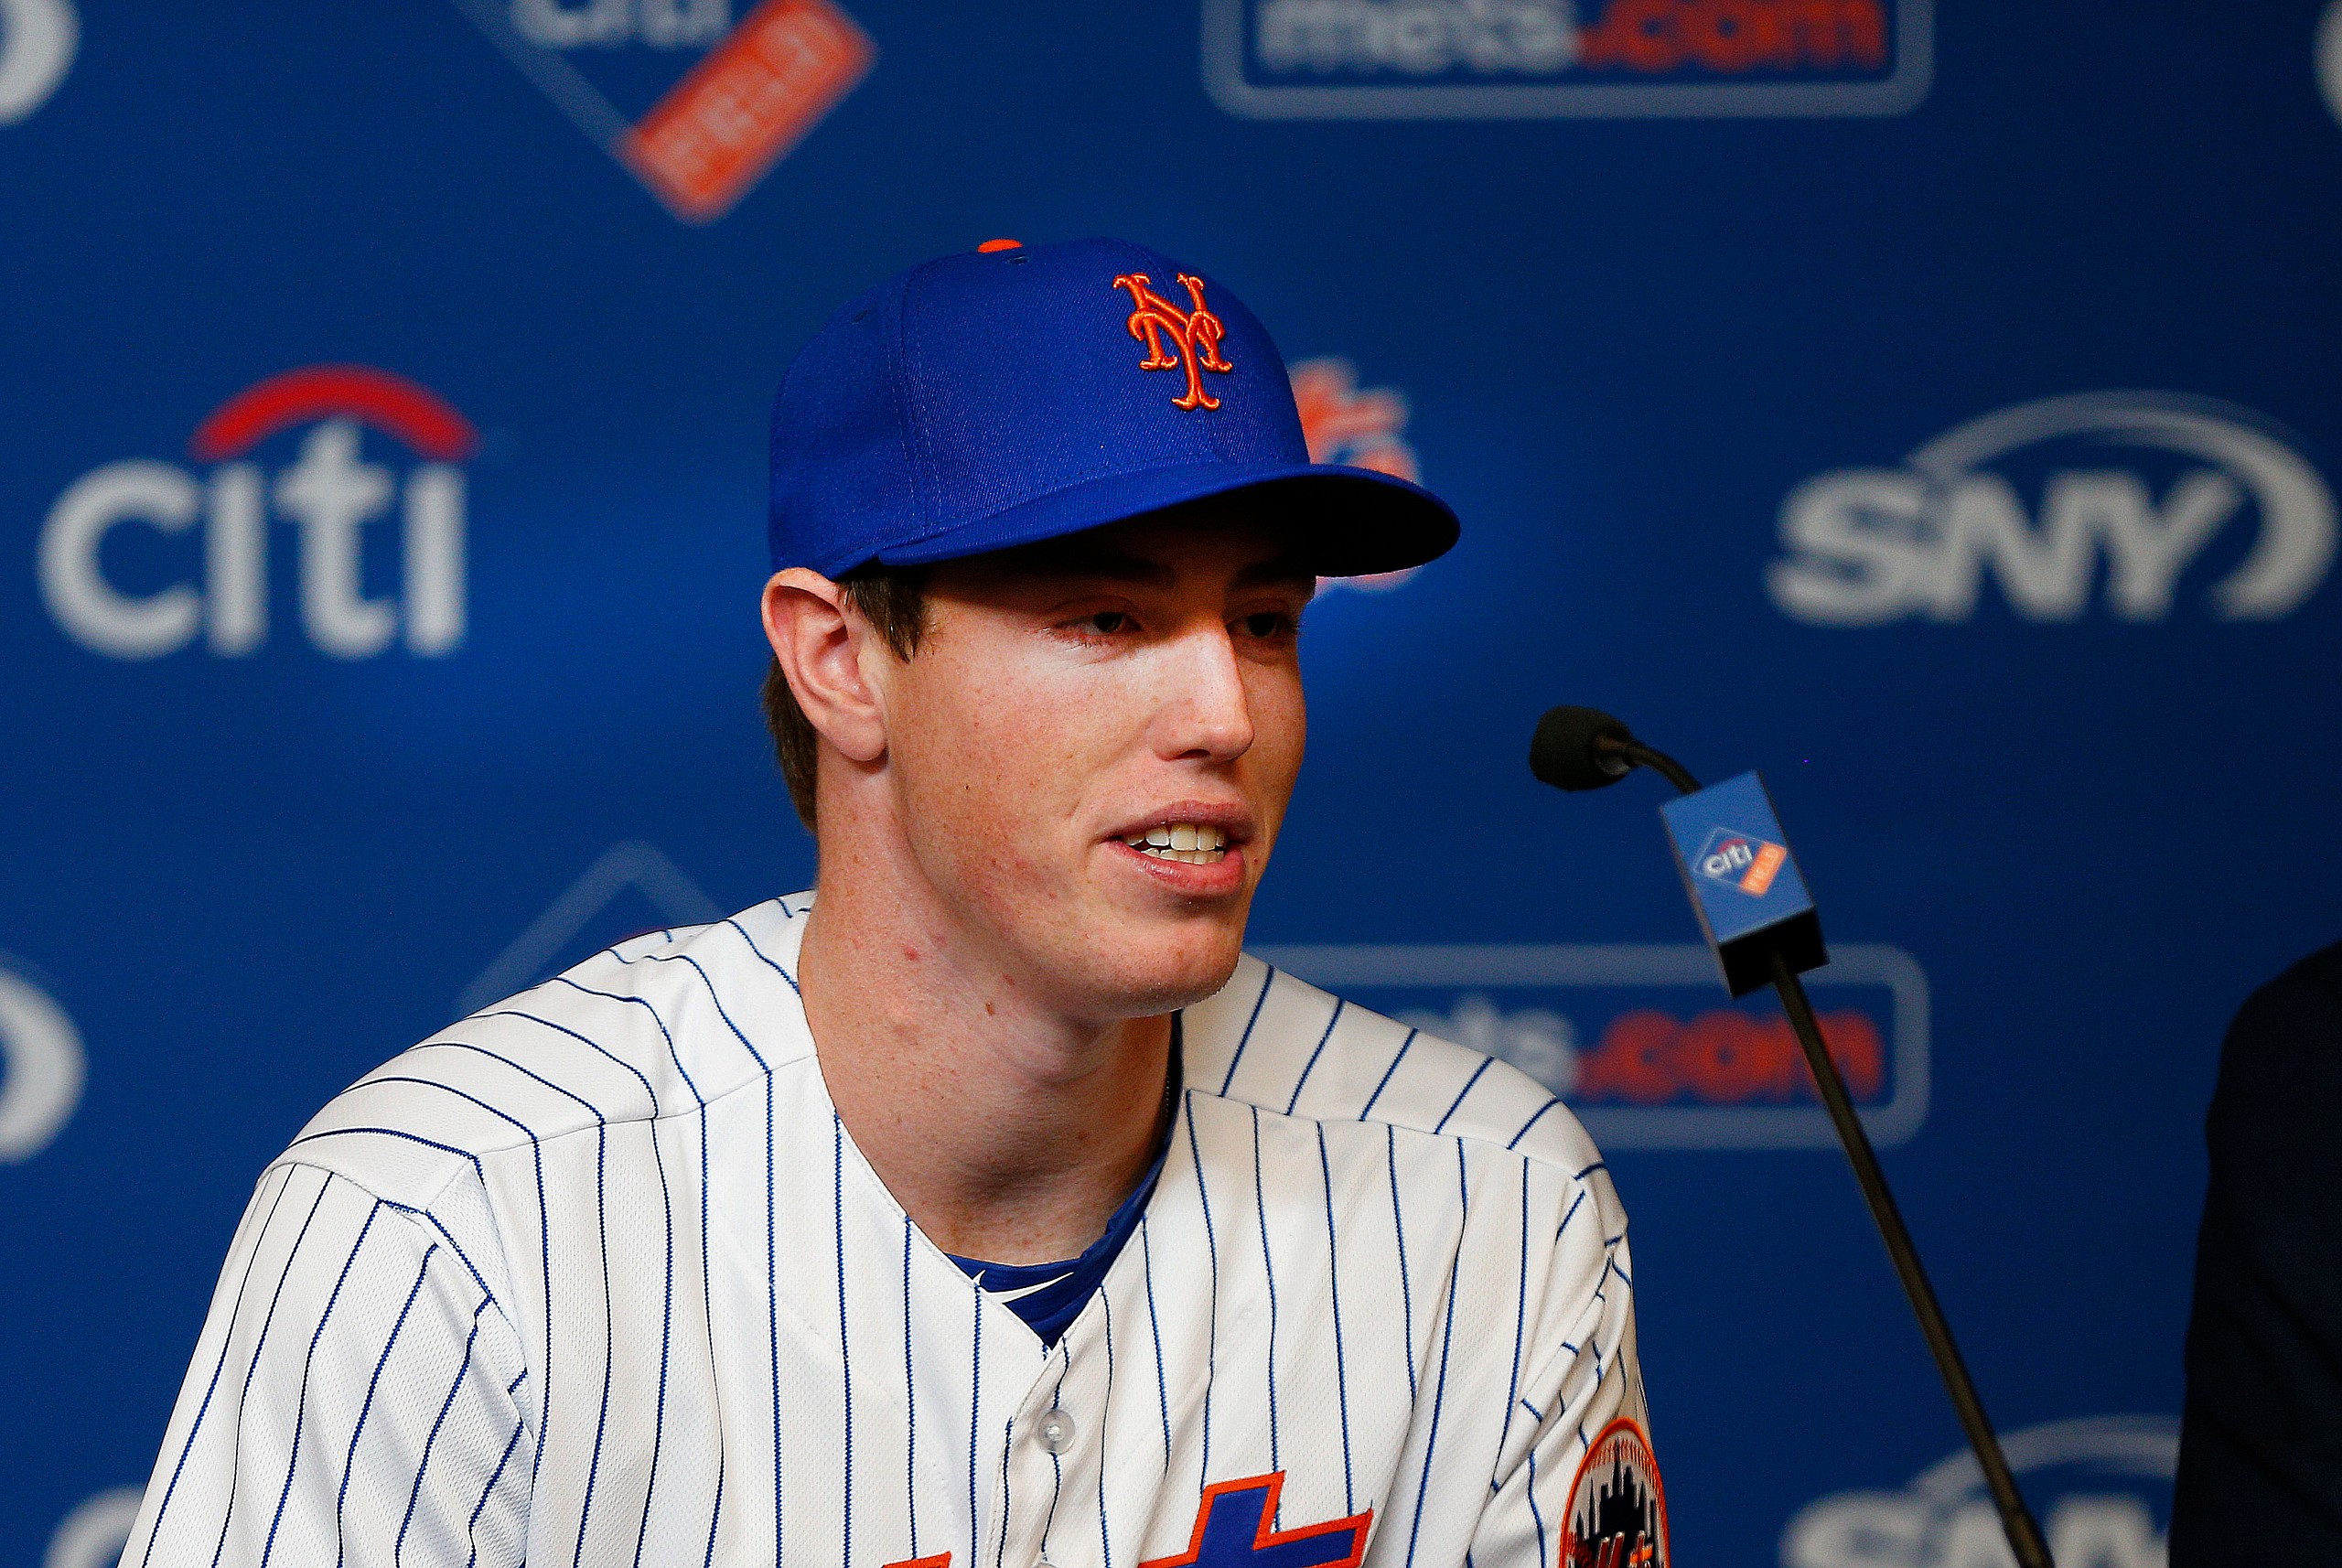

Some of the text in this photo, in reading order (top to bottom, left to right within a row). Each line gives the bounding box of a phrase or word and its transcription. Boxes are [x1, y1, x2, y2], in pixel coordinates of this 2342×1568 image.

[37, 417, 467, 660] citi
[1762, 465, 2246, 629] SNY
[1703, 843, 1754, 878] citi
